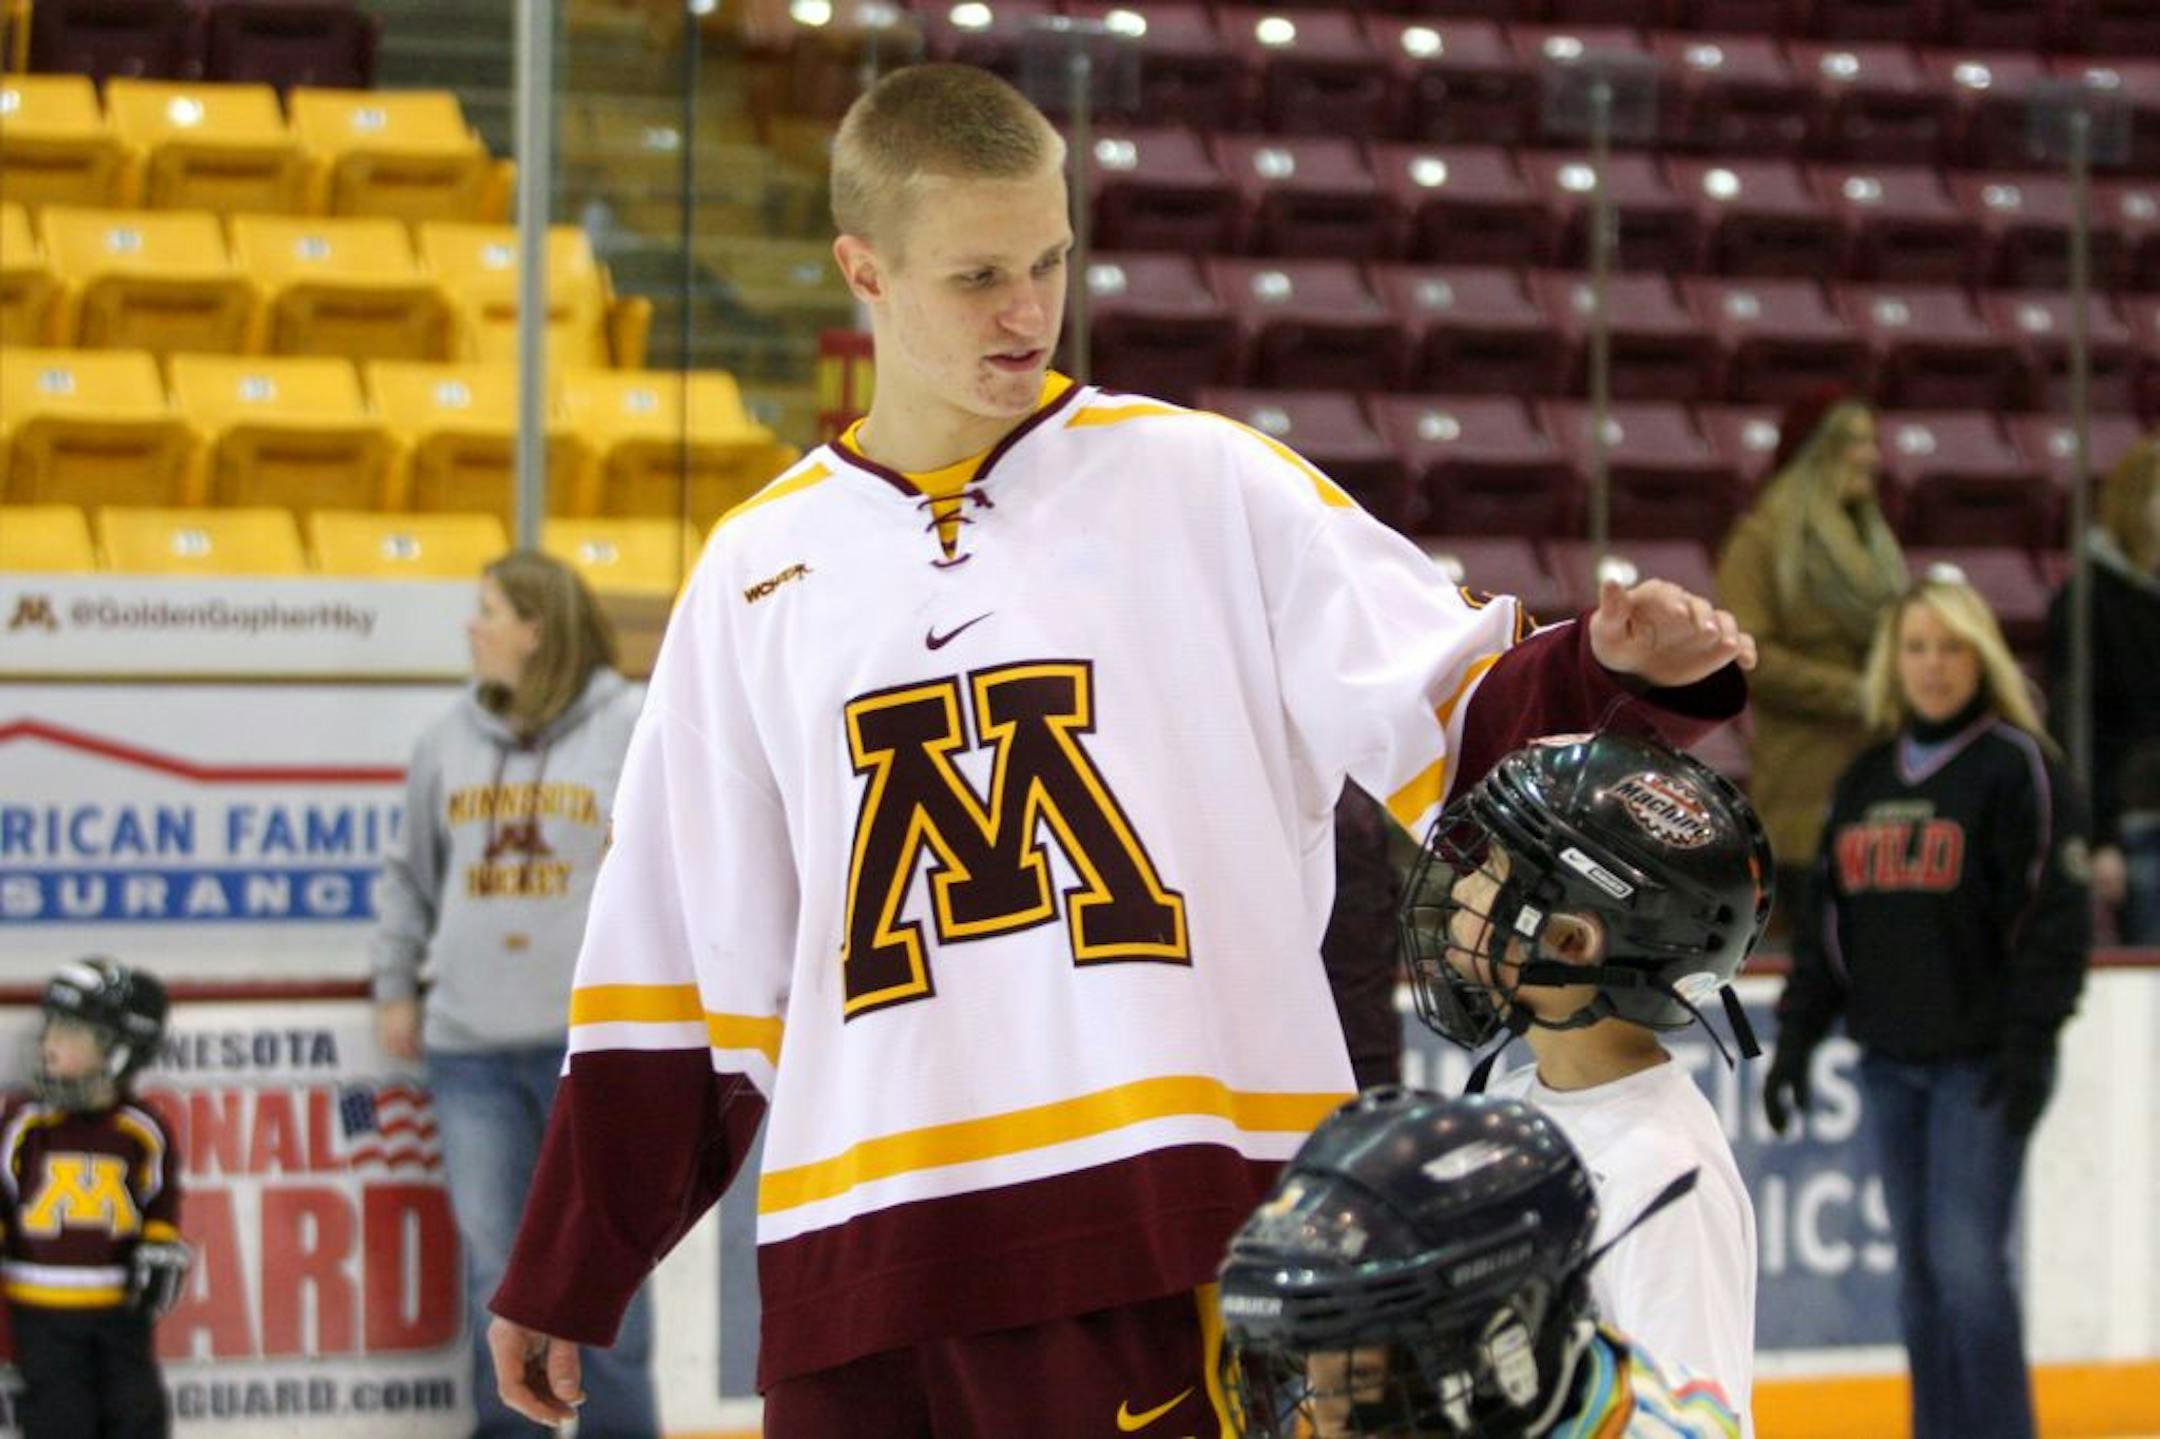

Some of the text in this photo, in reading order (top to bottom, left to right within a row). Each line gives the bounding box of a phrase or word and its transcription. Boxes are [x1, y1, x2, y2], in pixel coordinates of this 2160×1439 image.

[842, 658, 1192, 1025] M
[1837, 818, 1965, 892] WILD
[20, 1152, 144, 1237] M
